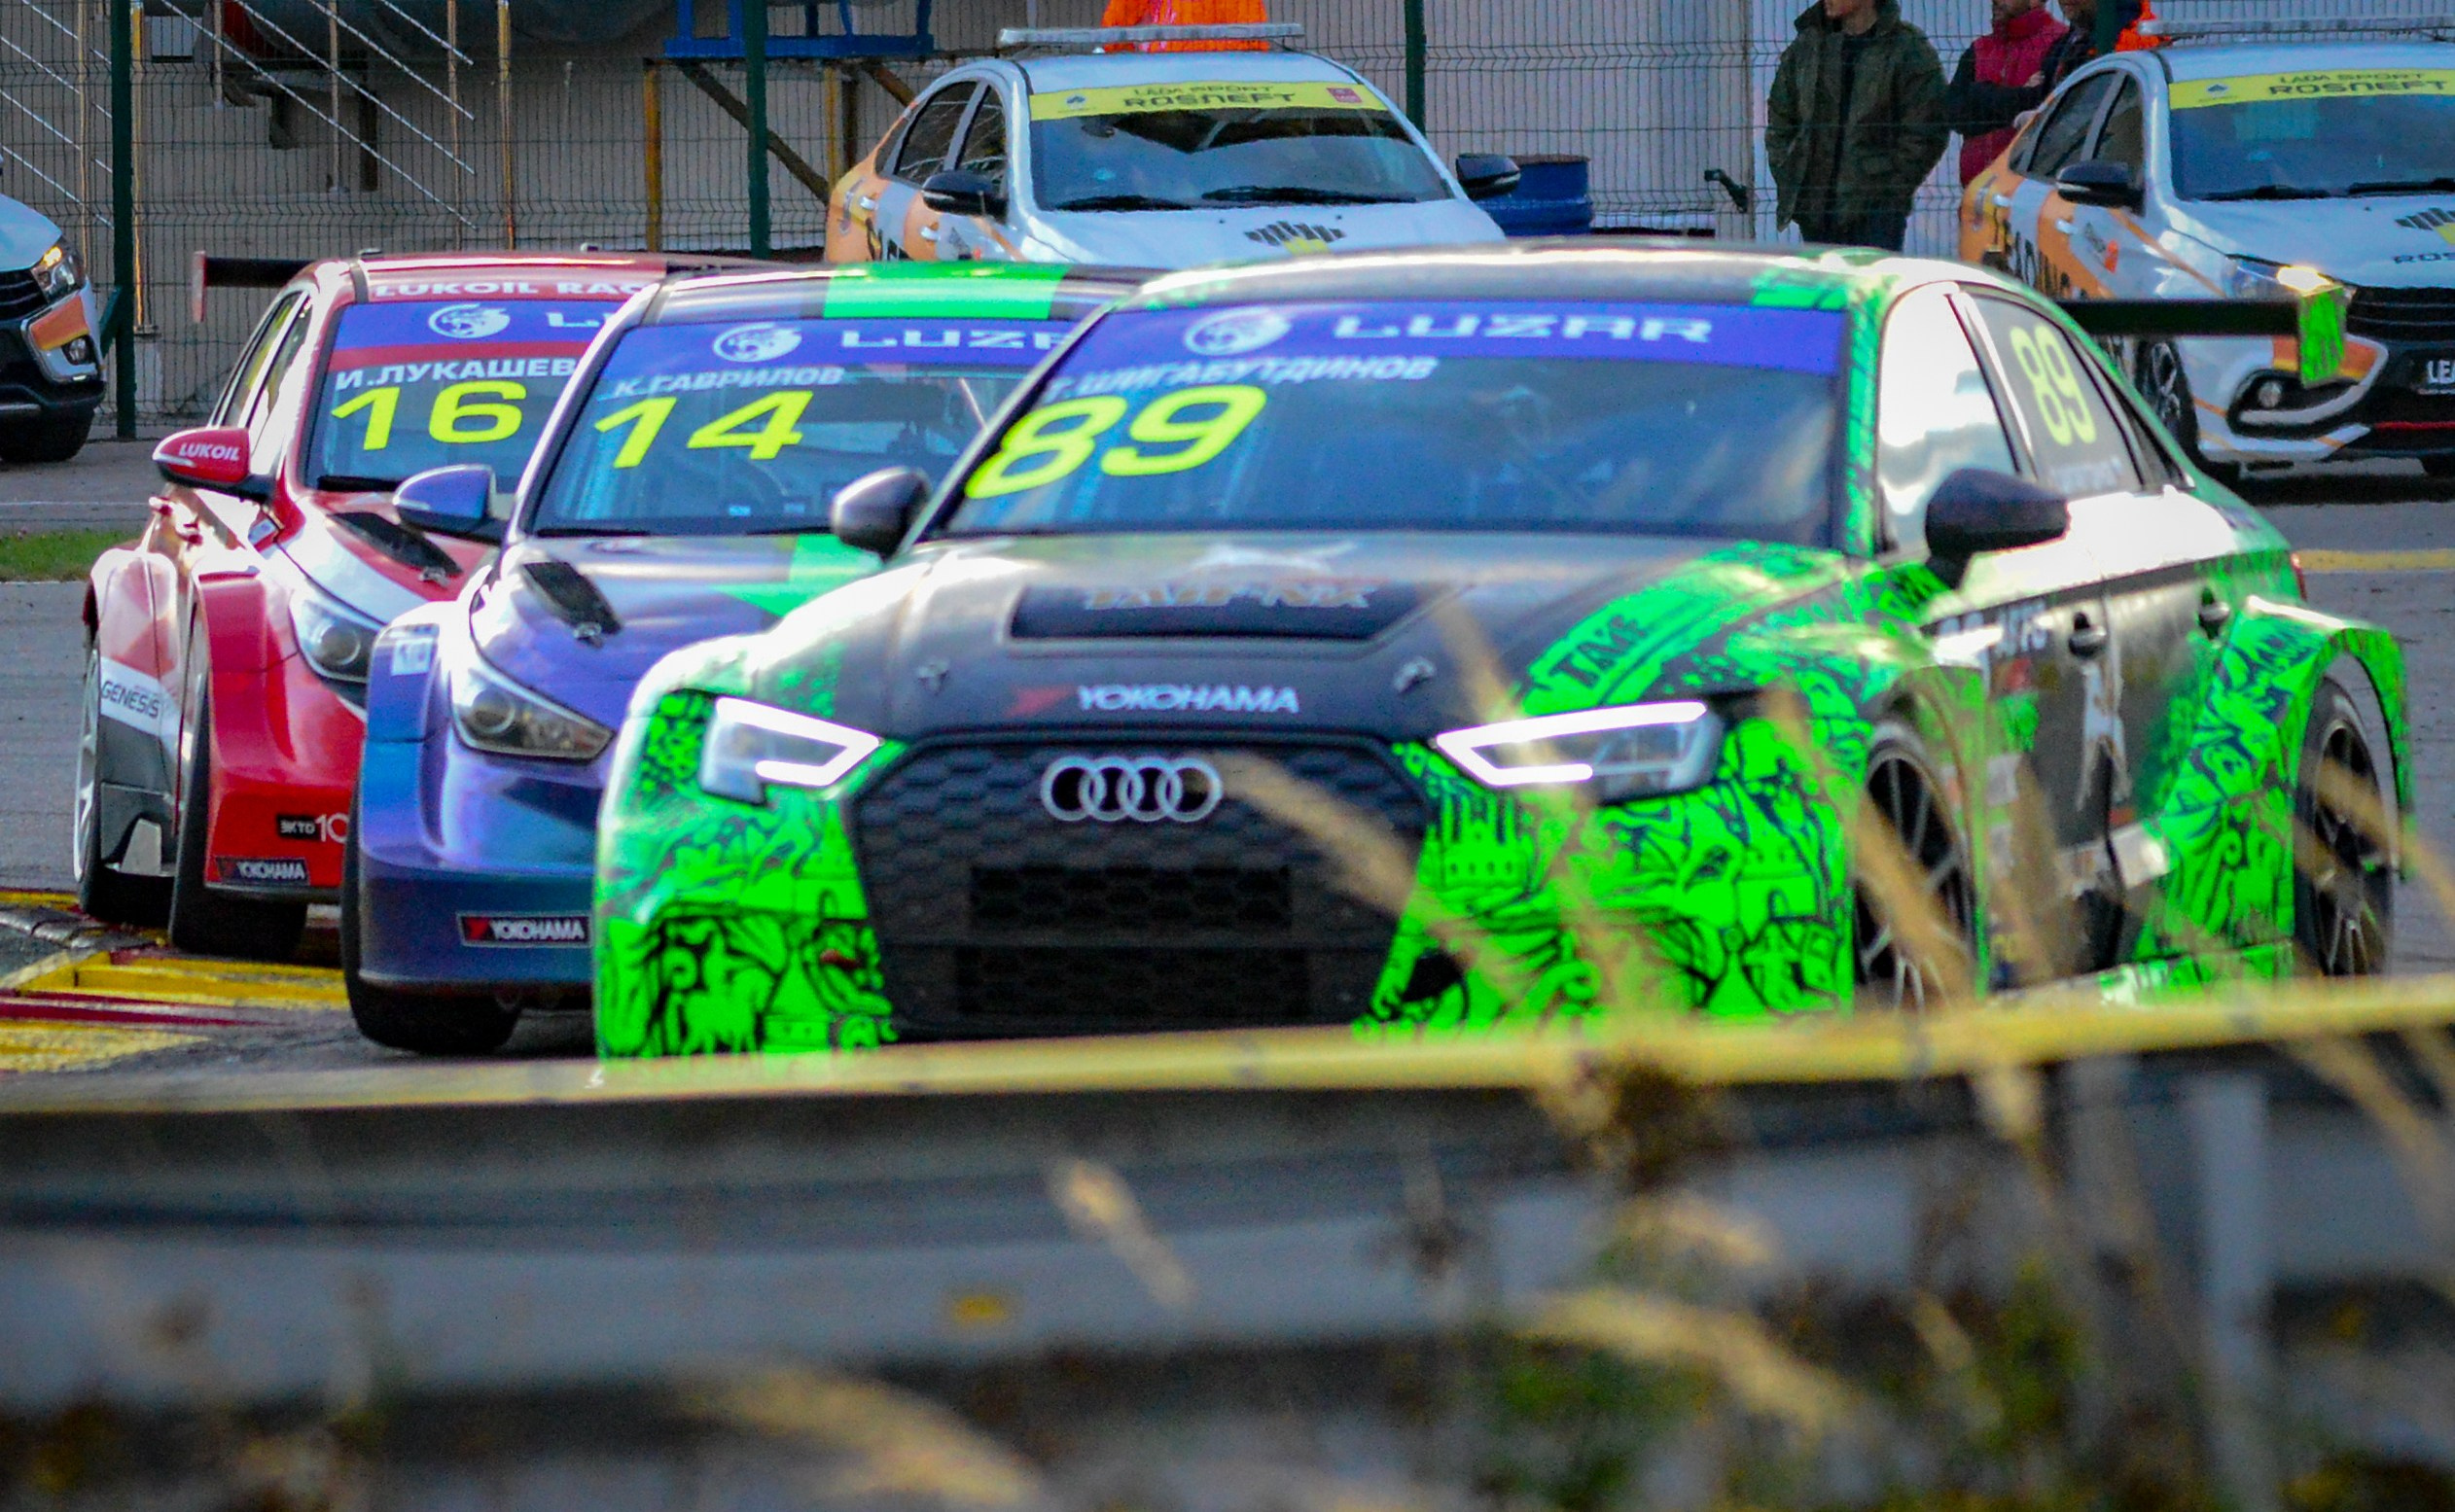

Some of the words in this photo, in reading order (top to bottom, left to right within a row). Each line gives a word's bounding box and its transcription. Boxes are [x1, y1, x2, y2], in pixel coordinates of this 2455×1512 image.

[2269, 81, 2446, 94] ROSNEFT
[2279, 74, 2330, 84] LADA
[1123, 92, 1296, 107] ROSNEFT
[375, 282, 539, 297] LUKOIL
[546, 311, 619, 328] L
[1334, 314, 1713, 343] LUZAR
[2427, 360, 2455, 384] LE
[2010, 325, 2096, 446] 89
[332, 380, 528, 451] 16
[594, 390, 814, 469] 14
[179, 442, 240, 462] LUKOIL
[965, 385, 1267, 499] 89
[101, 681, 161, 719] GENESIS
[1078, 685, 1299, 714] YOKOHAMA
[236, 861, 306, 880] YOKOHAMA
[489, 919, 586, 940] YOKOHAMA
